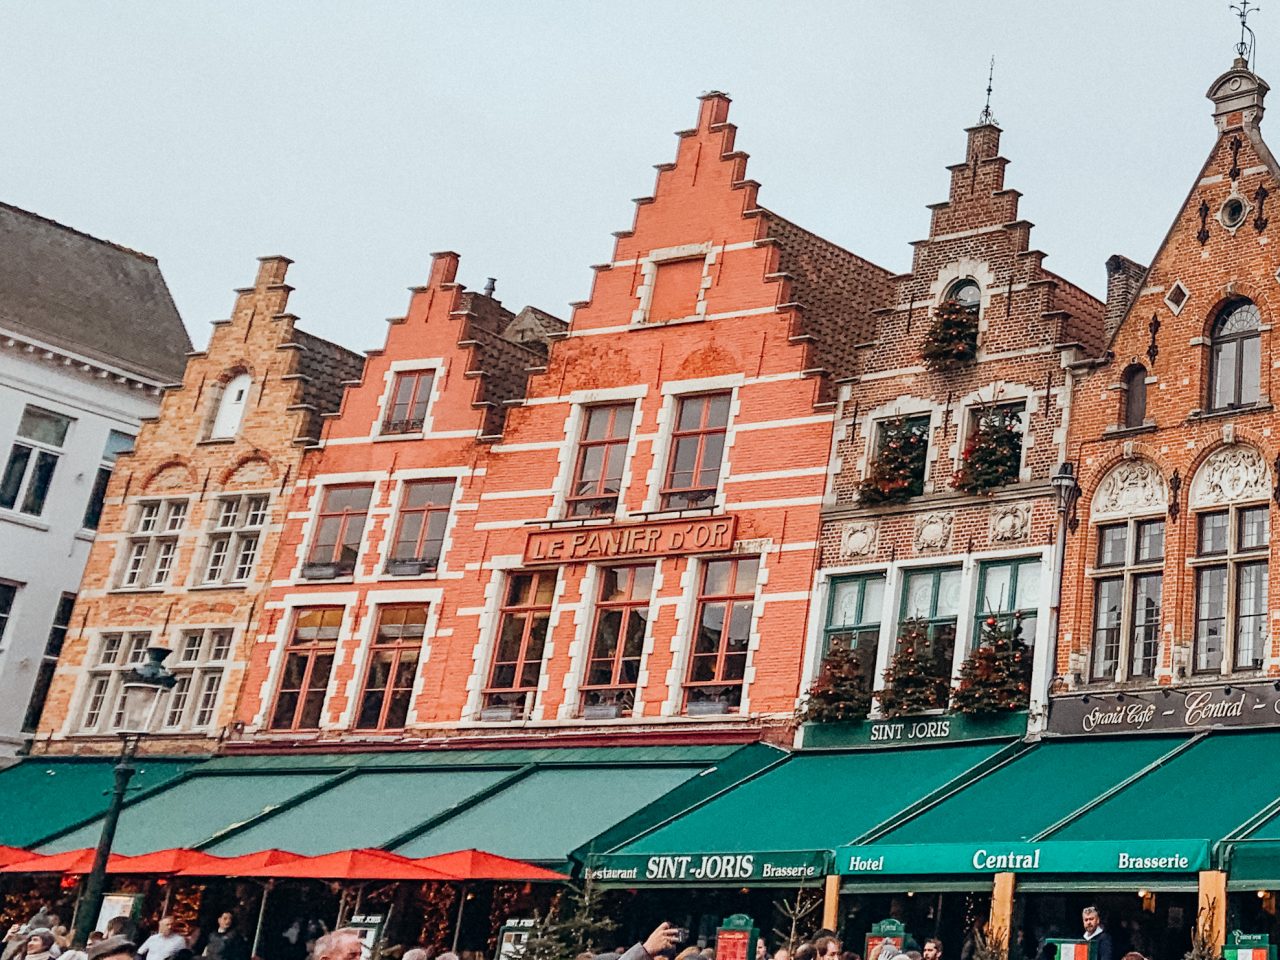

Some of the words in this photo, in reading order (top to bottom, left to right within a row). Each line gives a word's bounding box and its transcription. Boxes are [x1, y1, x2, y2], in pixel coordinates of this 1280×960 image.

[532, 541, 564, 560] LE
[570, 526, 662, 559] PANIER
[669, 522, 729, 551] D'OR
[1082, 704, 1126, 732] Grand
[1184, 691, 1246, 726] Central
[871, 724, 904, 741] SINT
[908, 721, 950, 739] JORIS
[646, 854, 754, 880] SINT-JORIS
[762, 863, 815, 878] Brasserie
[849, 856, 885, 871] Hotel
[973, 849, 1041, 869] Central
[1118, 853, 1189, 869] Brasserie
